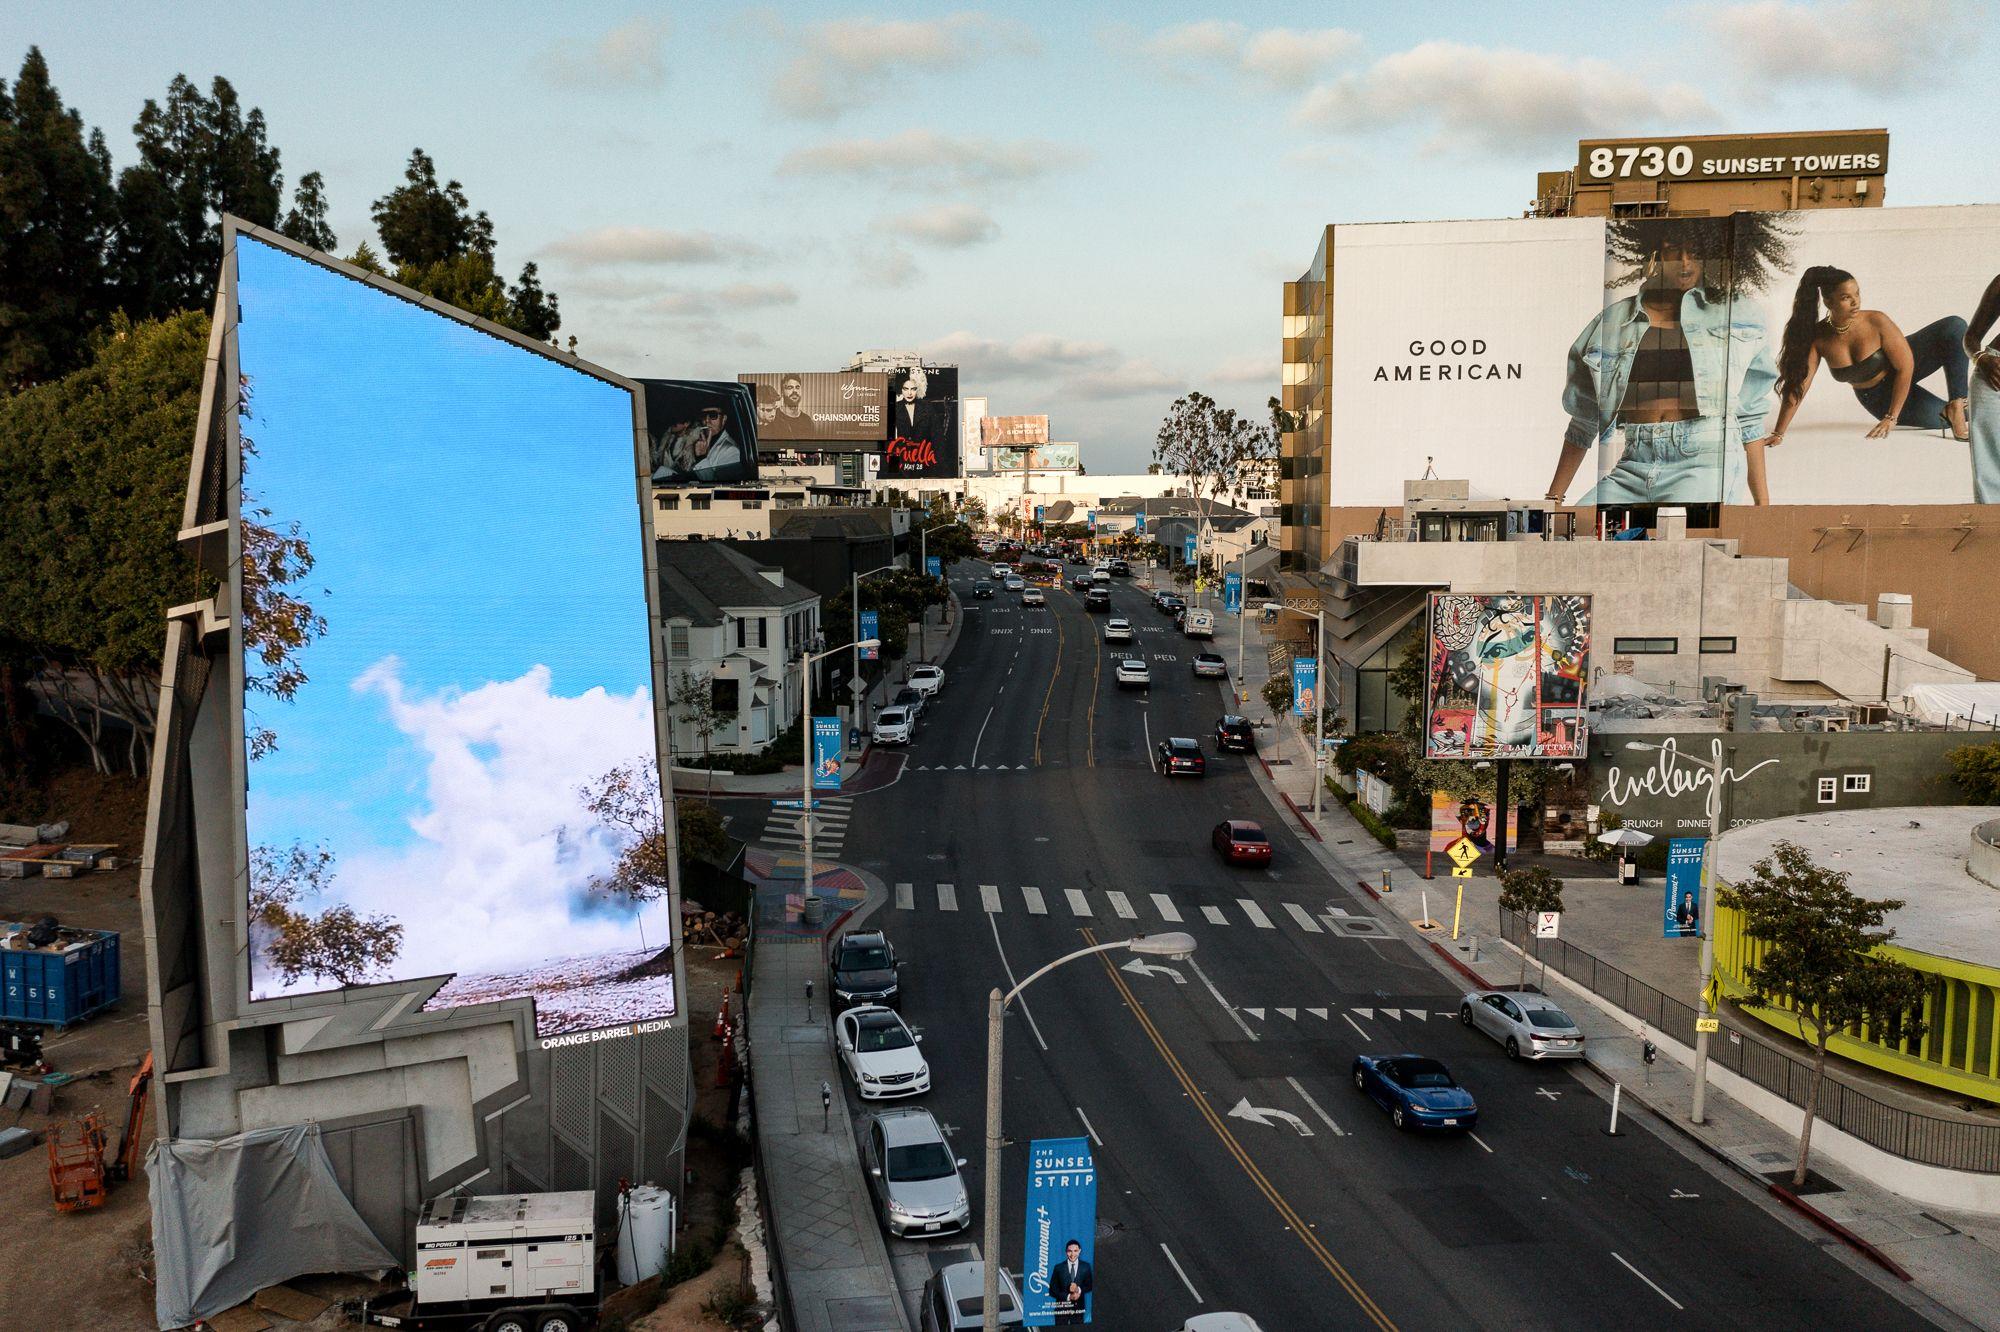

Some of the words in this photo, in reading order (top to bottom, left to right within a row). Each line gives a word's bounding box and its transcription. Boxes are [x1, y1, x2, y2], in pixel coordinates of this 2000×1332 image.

[1589, 145, 1694, 179] 8730
[1702, 157, 1786, 175] SUNSET
[1791, 153, 1880, 171] TOWERS
[1409, 339, 1487, 357] GOOD
[1373, 363, 1522, 382] AMERICAN
[863, 405, 880, 414] THE
[812, 413, 880, 422] CHAINSMOKERS
[1110, 652, 1133, 660] PED
[1154, 653, 1177, 661] PED
[1536, 743, 1581, 751] PITTMAN
[1621, 819, 1663, 828] BRUNCH
[1671, 847, 1702, 855] SUNSET
[1670, 856, 1701, 864] STRIP
[9, 969, 16, 979] W
[541, 1032, 590, 1050] ORANGE
[591, 1026, 633, 1042] BARREL
[637, 1020, 672, 1034] MEDIA
[1035, 1156, 1093, 1169] SUNSET
[1035, 1174, 1094, 1188] STRIP
[1028, 1205, 1052, 1297] Paramount+
